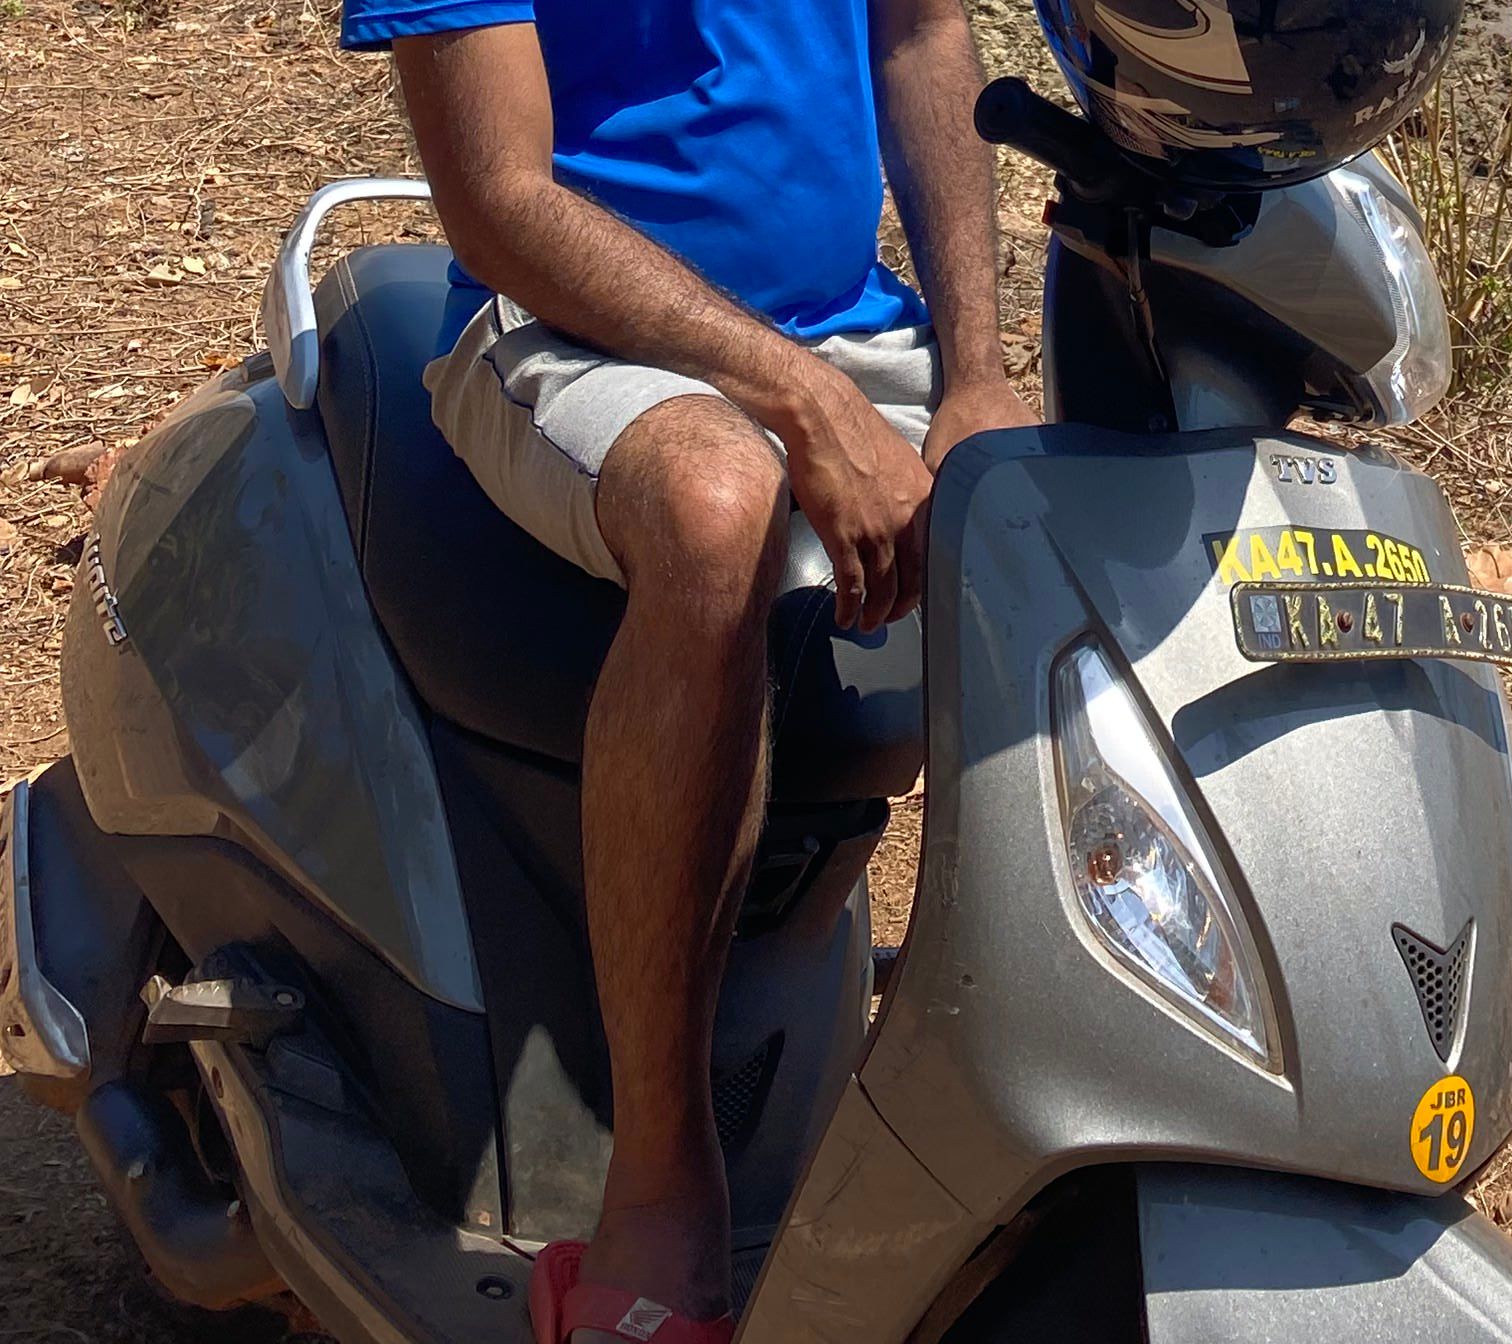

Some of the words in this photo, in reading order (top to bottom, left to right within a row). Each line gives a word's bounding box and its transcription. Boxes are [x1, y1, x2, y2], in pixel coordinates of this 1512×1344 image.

[1270, 454, 1337, 484] TVS
[1212, 530, 1431, 585] KA47.A.2650
[1258, 634, 1282, 649] IND
[1430, 1088, 1466, 1109] JBR
[1419, 1110, 1467, 1171] 19
